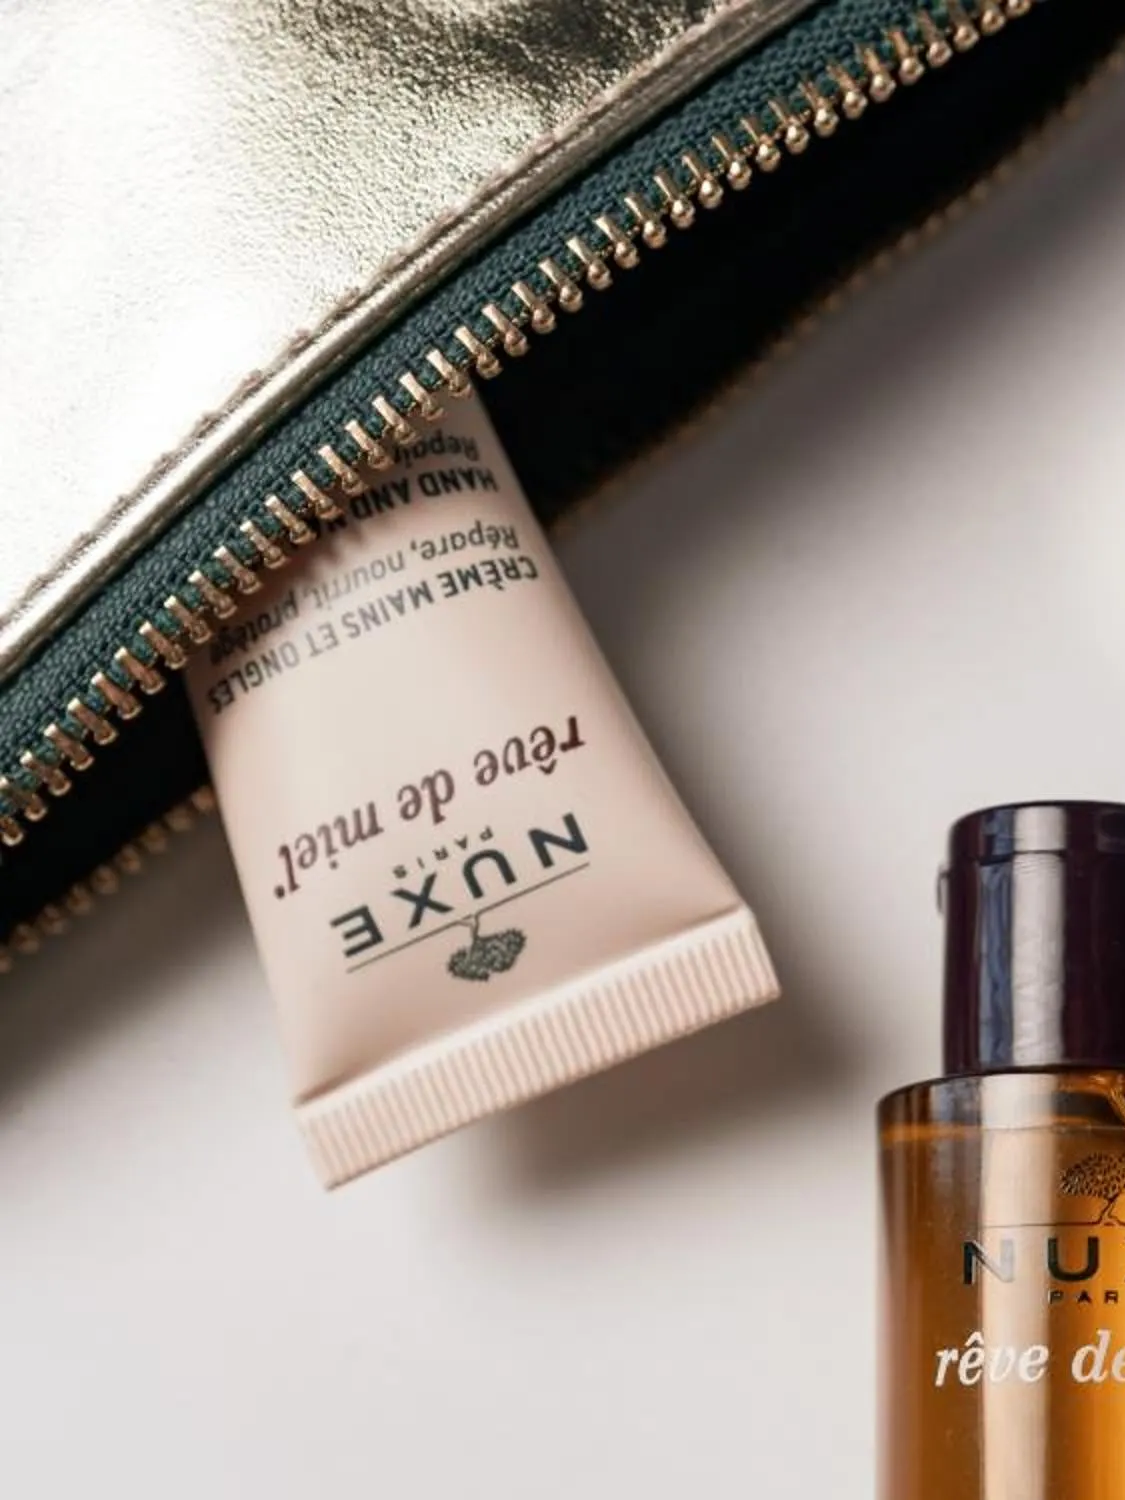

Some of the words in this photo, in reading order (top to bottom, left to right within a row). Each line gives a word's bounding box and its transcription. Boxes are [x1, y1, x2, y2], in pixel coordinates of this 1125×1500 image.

[351, 477, 412, 520] AND
[418, 468, 500, 497] HAND
[411, 519, 520, 562] Répare,
[443, 555, 539, 600] CRÈME
[340, 578, 435, 640] MAINS
[304, 621, 340, 659] ET
[207, 640, 301, 715] ONGLES
[473, 715, 586, 787] rêve
[396, 768, 456, 825] de
[392, 825, 494, 880] PARIS
[329, 811, 589, 959] NUXE
[933, 1330, 1050, 1387] rêve
